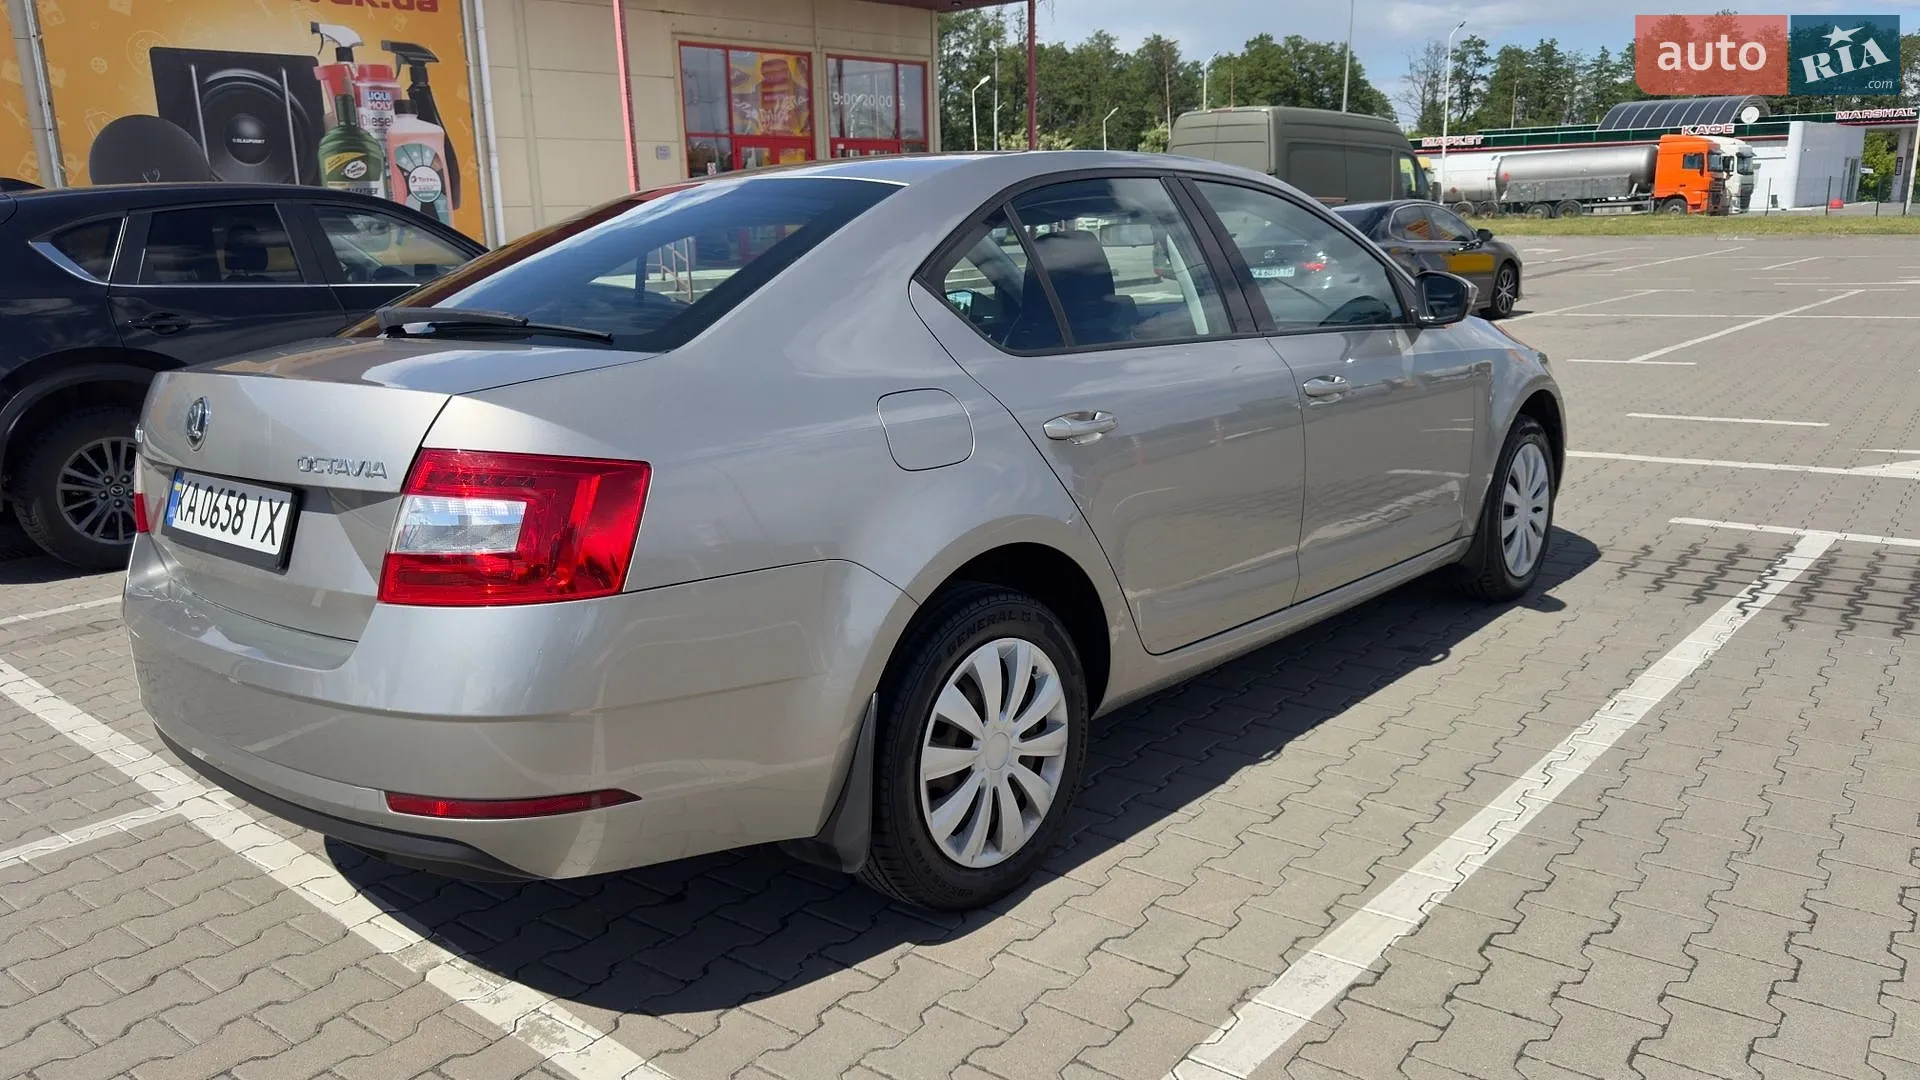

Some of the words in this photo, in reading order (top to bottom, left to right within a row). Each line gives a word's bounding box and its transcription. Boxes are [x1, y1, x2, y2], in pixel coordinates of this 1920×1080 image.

[1836, 108, 1916, 120] MARSHAL
[1681, 123, 1734, 135] КАФЕ
[297, 456, 388, 479] OCTAVIA
